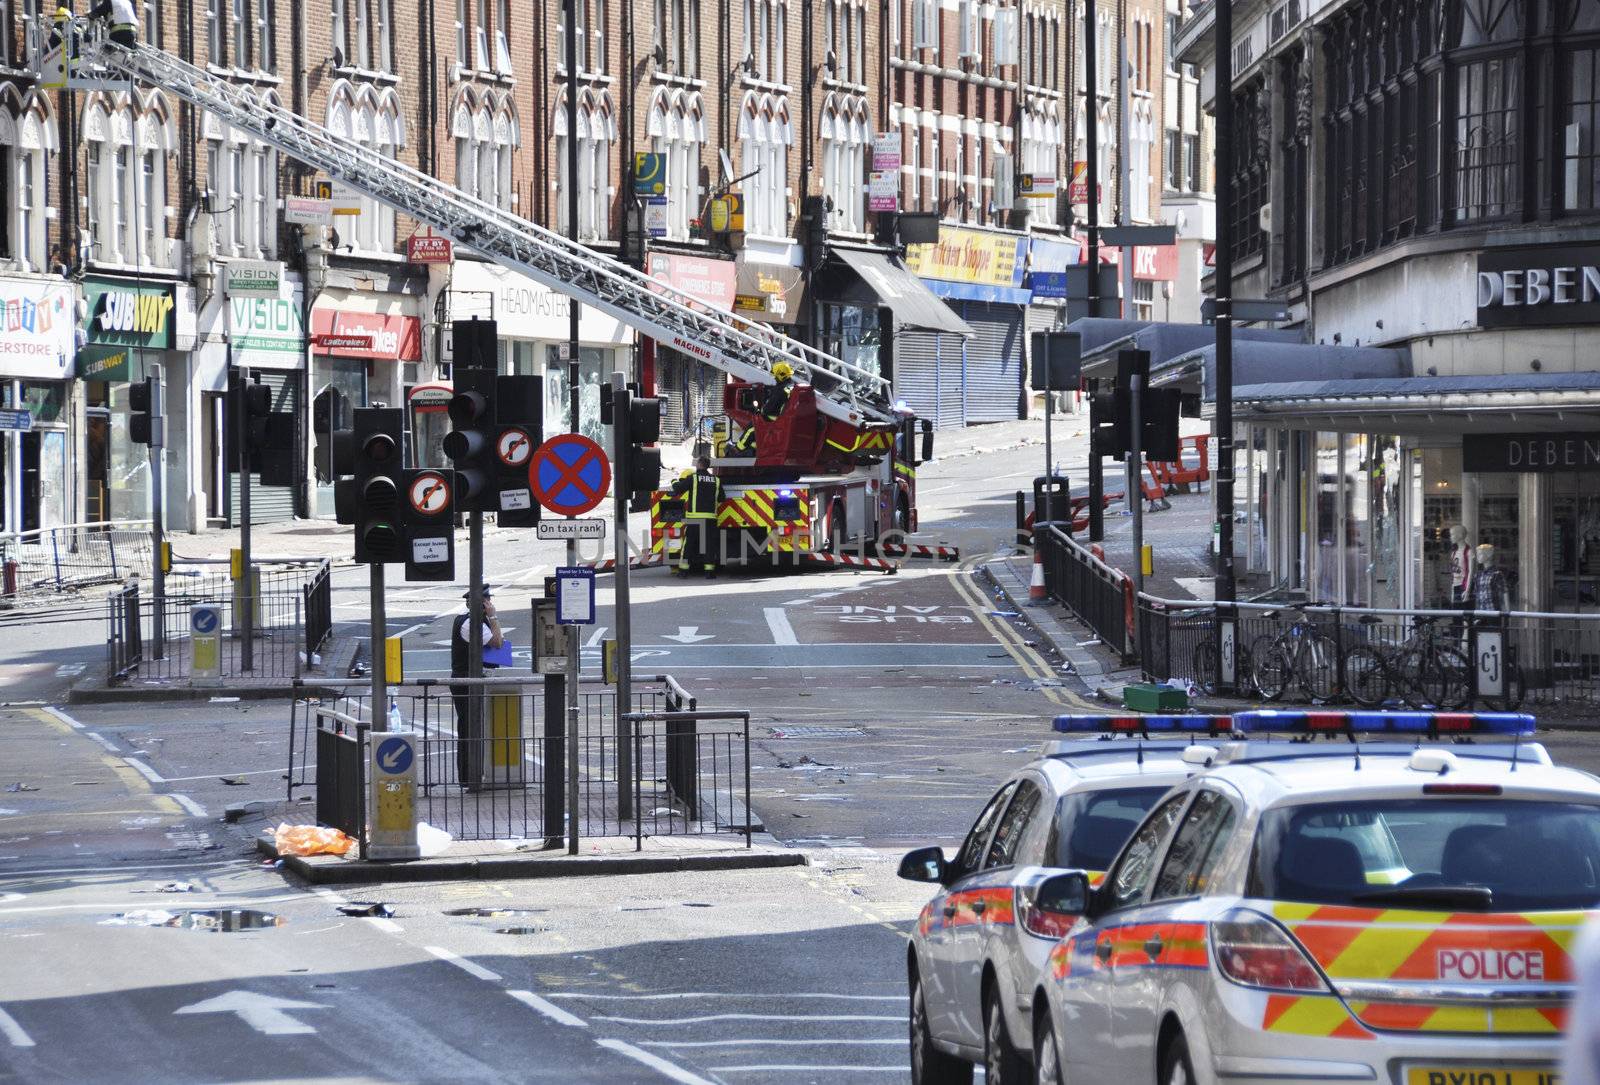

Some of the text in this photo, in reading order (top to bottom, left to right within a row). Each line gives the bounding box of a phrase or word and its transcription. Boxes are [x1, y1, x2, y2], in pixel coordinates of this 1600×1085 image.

[411, 251, 449, 259] ANDREWS
[1136, 246, 1158, 275] KFC
[229, 269, 280, 280] VISION
[96, 291, 174, 333] SUBWAY
[232, 297, 305, 333] VISION
[322, 336, 366, 347] Ladbrokes
[673, 337, 711, 359] MAGIRUS
[85, 351, 127, 376] SUBWAY
[698, 475, 716, 483] FIRE
[540, 524, 602, 533] On taxi rank
[813, 605, 991, 614] LANE
[838, 615, 974, 624] BUS
[1481, 645, 1499, 682] cj
[1438, 951, 1543, 980] POLICE
